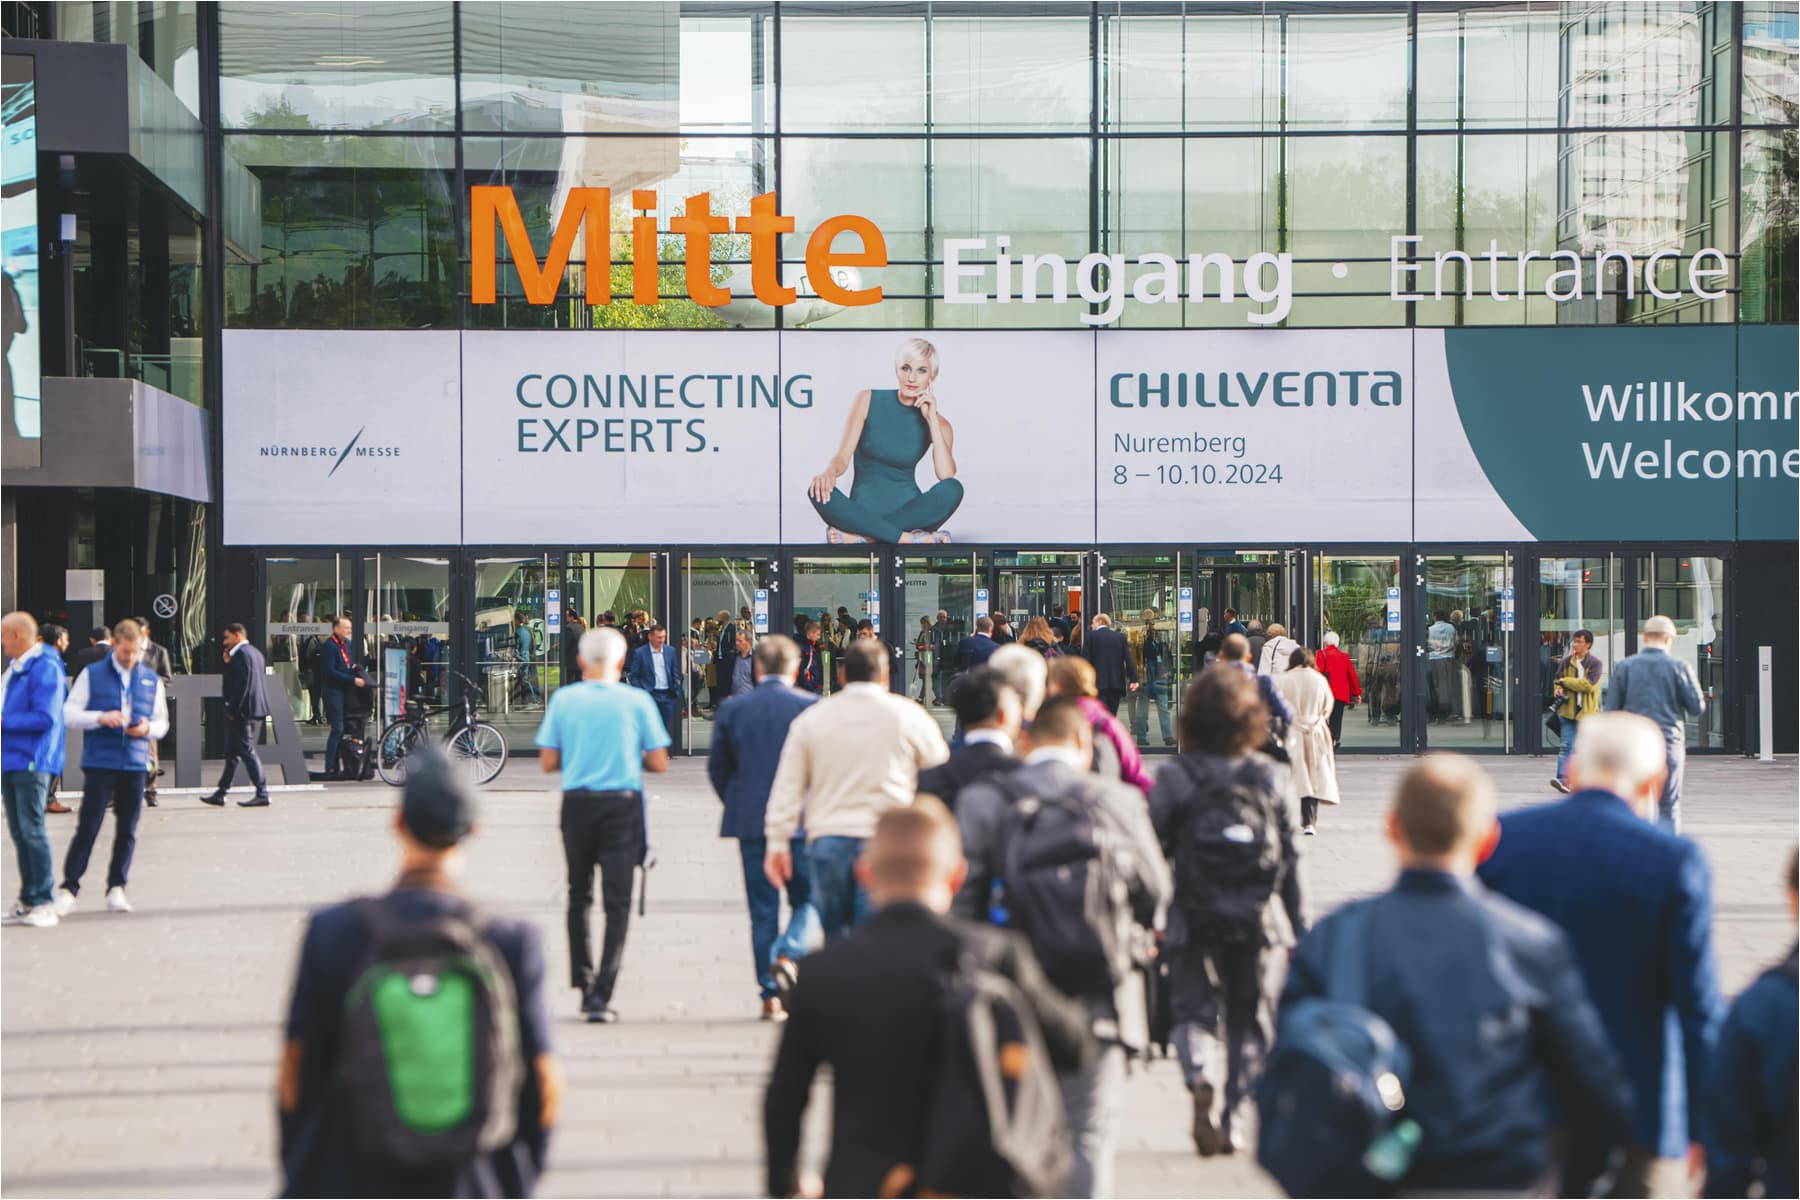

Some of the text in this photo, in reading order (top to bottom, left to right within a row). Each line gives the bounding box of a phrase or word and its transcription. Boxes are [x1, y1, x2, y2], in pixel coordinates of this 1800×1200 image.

[470, 186, 1729, 324] Mitte Eingang Entrance
[516, 374, 814, 409] CONNECTING
[517, 418, 720, 453] EXPERTS.
[1114, 431, 1246, 458] Nuremberg
[1113, 464, 1128, 485] 8
[1157, 463, 1283, 485] 10.10.2024
[282, 624, 320, 633] Entrance
[394, 624, 429, 633] Eingang
